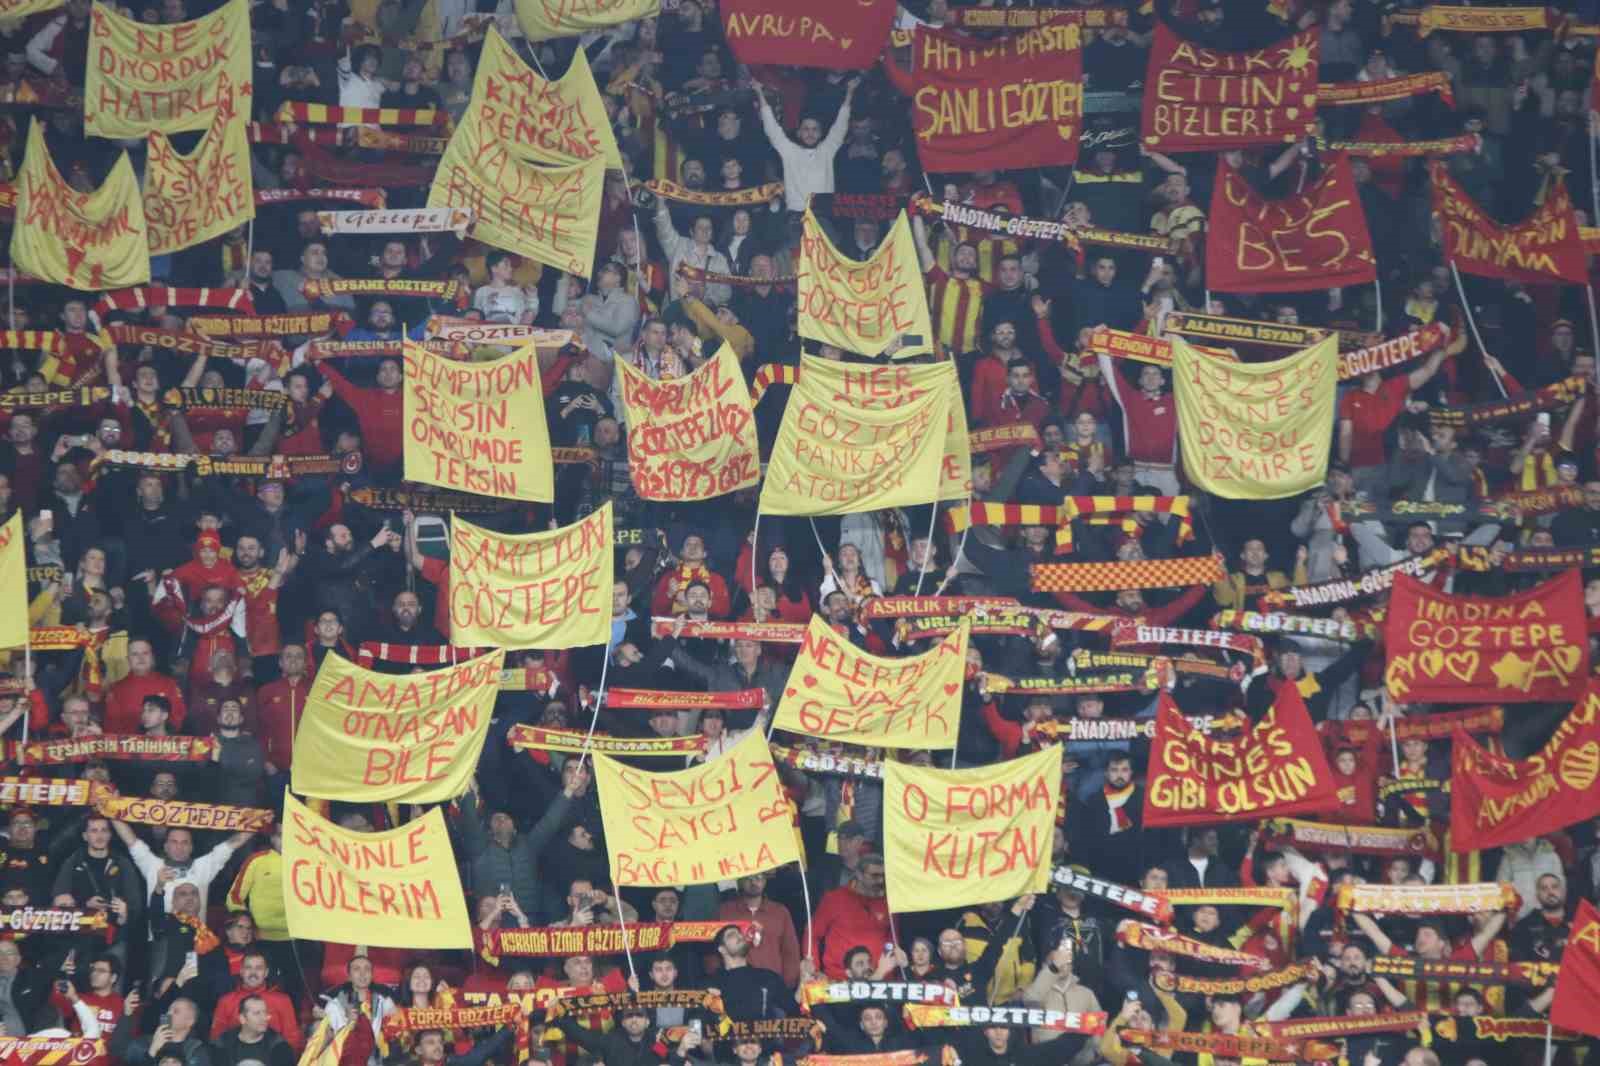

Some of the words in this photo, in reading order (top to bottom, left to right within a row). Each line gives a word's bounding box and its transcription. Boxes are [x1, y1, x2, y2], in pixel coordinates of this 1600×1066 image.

[727, 13, 833, 43] AVRUPA
[452, 565, 600, 630] GÖZTEPE
[343, 703, 478, 744] OYNASAN
[362, 740, 456, 786] BİLE
[1217, 757, 1317, 814] OLSUN
[903, 783, 928, 822] O
[945, 774, 1052, 823] FORMA
[290, 857, 442, 920] GÜLERİM
